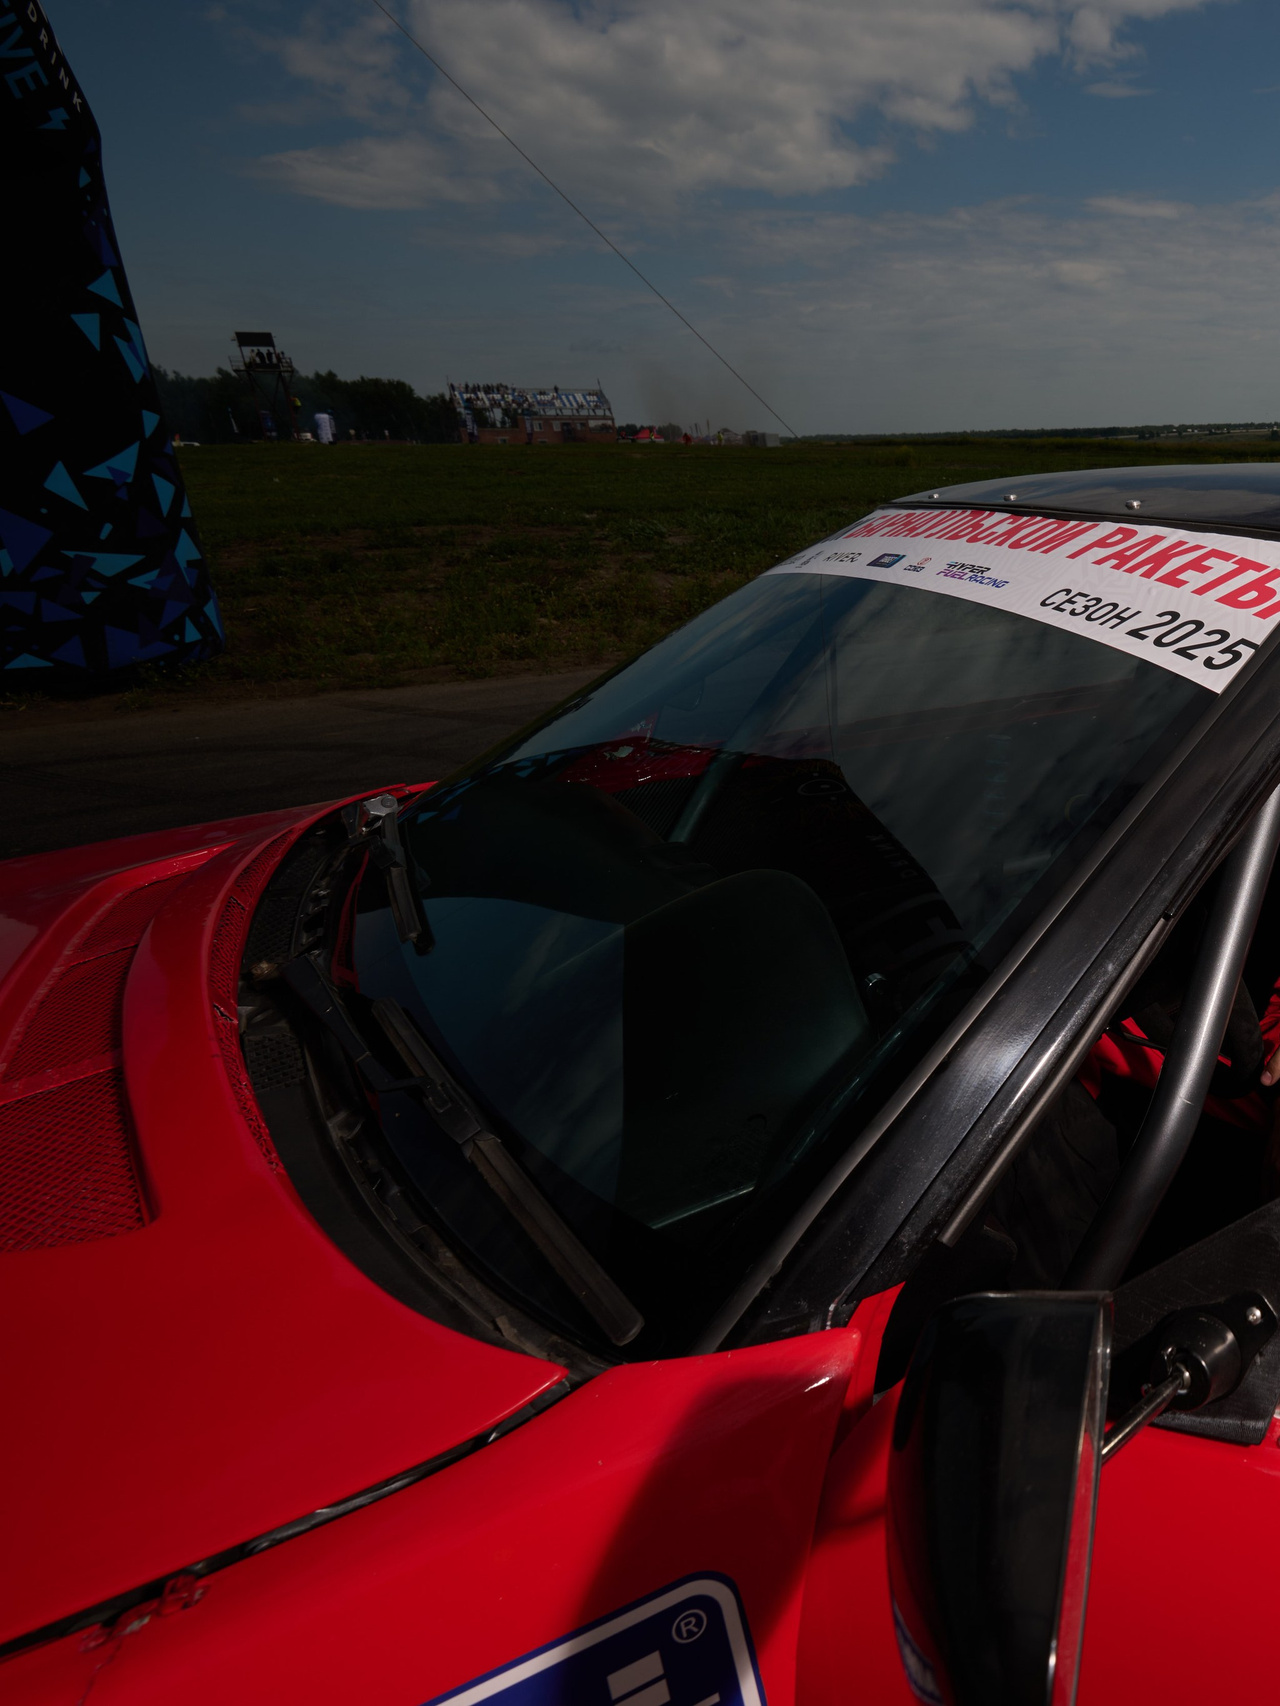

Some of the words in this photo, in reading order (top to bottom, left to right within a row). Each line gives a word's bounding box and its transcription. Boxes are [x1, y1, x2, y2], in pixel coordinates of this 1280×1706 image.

[0, 0, 49, 99] IVE
[1039, 588, 1142, 630] СЕЗОН
[1125, 610, 1259, 670] 2025
